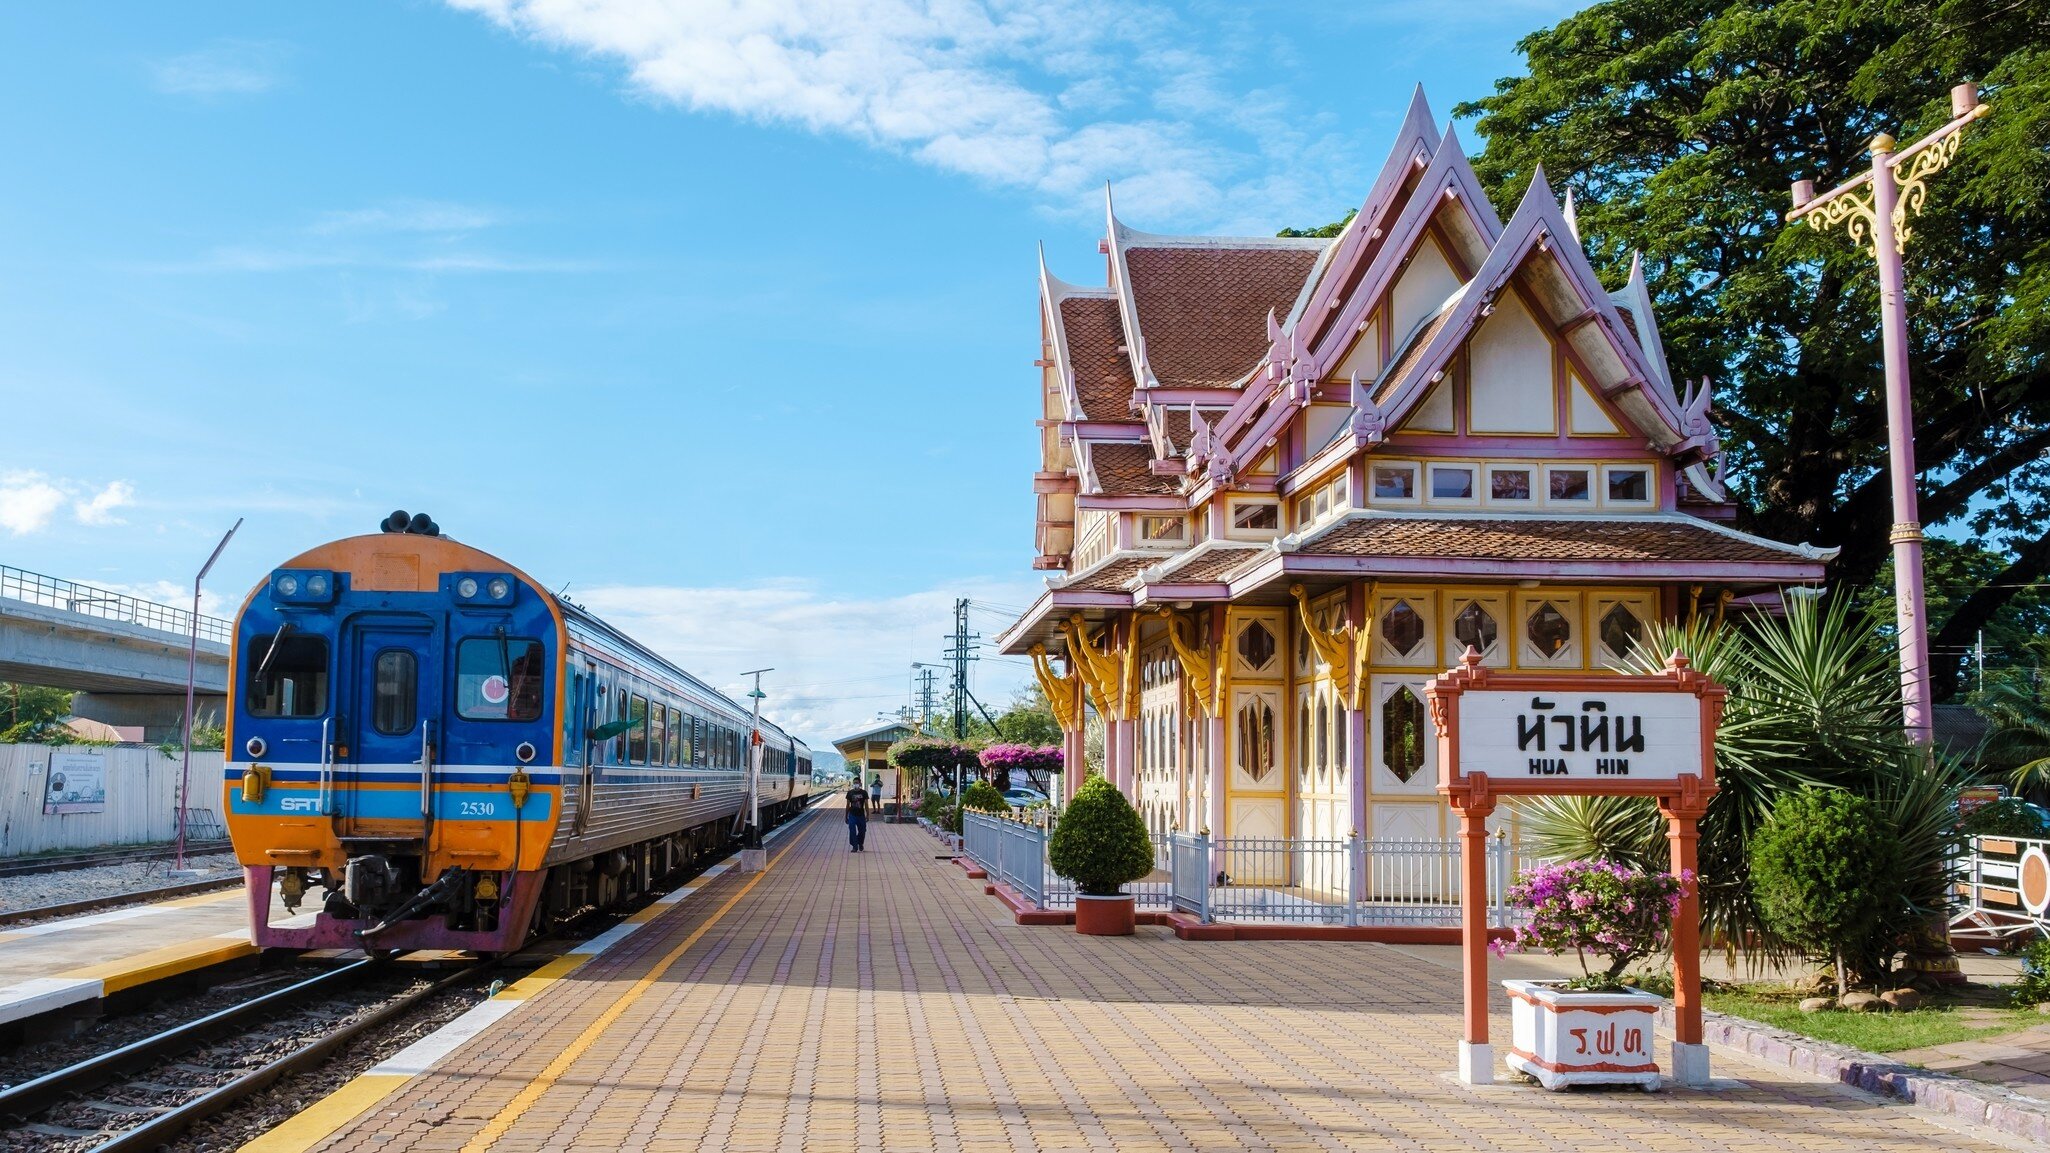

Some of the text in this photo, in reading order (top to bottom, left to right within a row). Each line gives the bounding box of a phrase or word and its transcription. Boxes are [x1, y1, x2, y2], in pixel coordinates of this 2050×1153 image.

[1517, 696, 1645, 753] หัวหิน
[1528, 758, 1629, 775] HUA HIN
[460, 801, 495, 816] 2530
